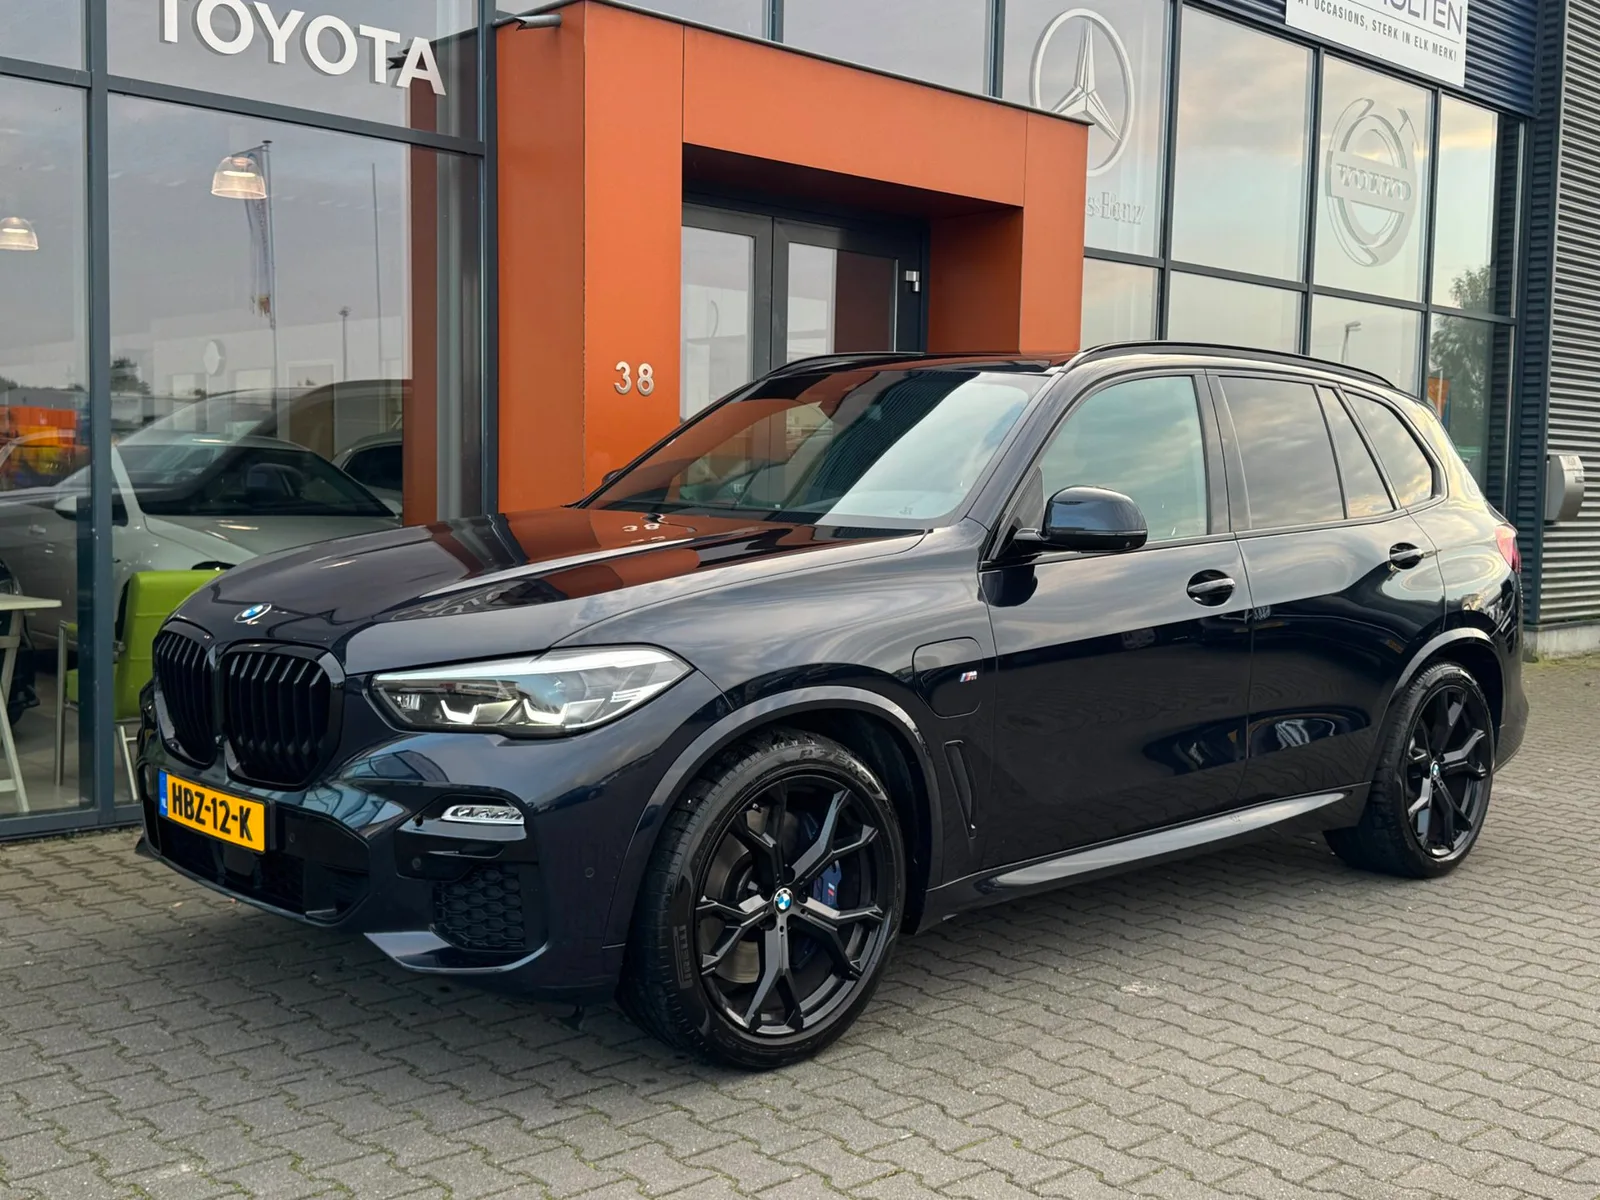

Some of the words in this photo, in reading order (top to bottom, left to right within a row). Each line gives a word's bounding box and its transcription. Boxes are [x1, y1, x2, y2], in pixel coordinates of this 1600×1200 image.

[1314, 0, 1368, 31] OCCASIONS,
[1371, 19, 1399, 40] STERK
[1402, 31, 1411, 44] IN
[1414, 35, 1429, 51] ELK
[1432, 42, 1457, 62] MERK!
[1384, 0, 1463, 35] LTEN
[163, 0, 447, 96] TOYOTA
[1336, 163, 1412, 201] VOLVO
[613, 360, 655, 397] 38
[171, 782, 253, 842] HBZ-12-K
